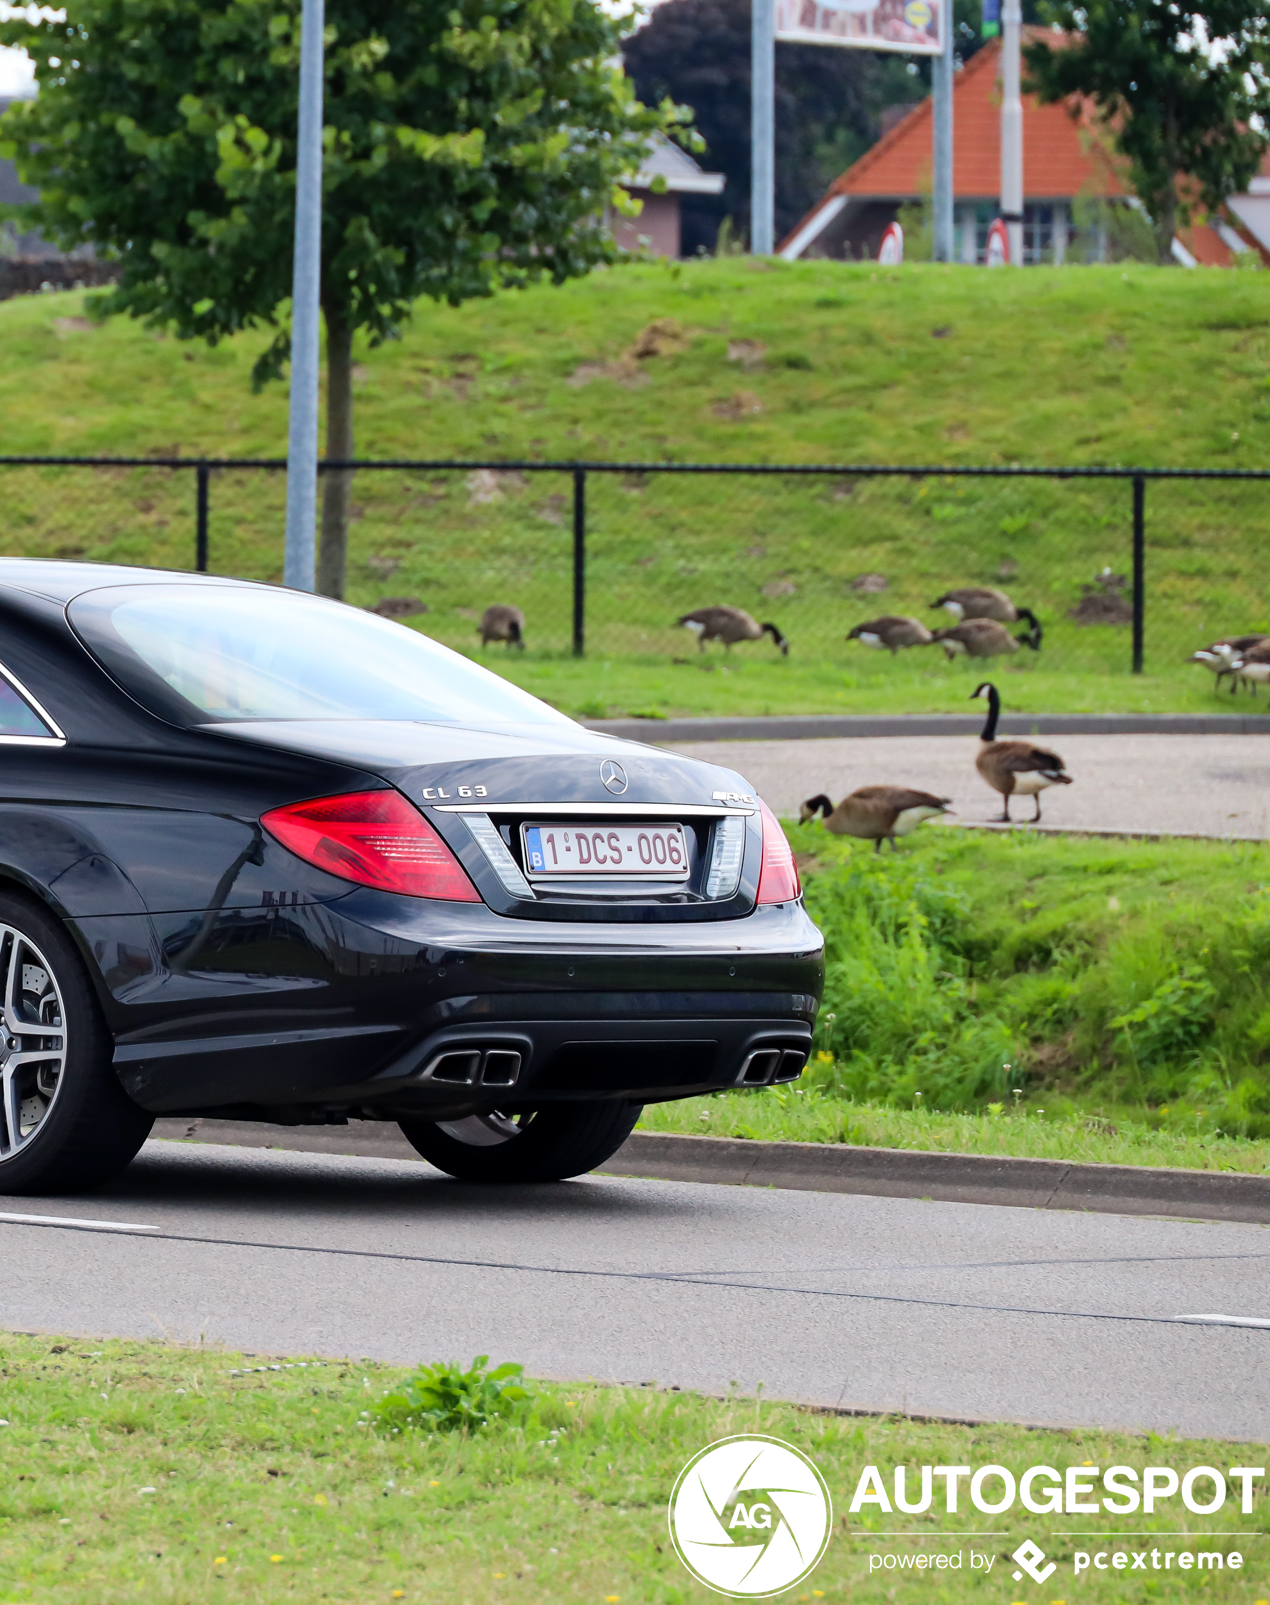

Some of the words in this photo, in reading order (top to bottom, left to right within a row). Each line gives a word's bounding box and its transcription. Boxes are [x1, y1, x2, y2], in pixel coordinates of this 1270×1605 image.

[422, 787, 451, 800] CL
[457, 785, 488, 798] 63
[725, 791, 755, 804] AMG
[546, 832, 682, 865] 1-DCS-006
[532, 851, 543, 867] B
